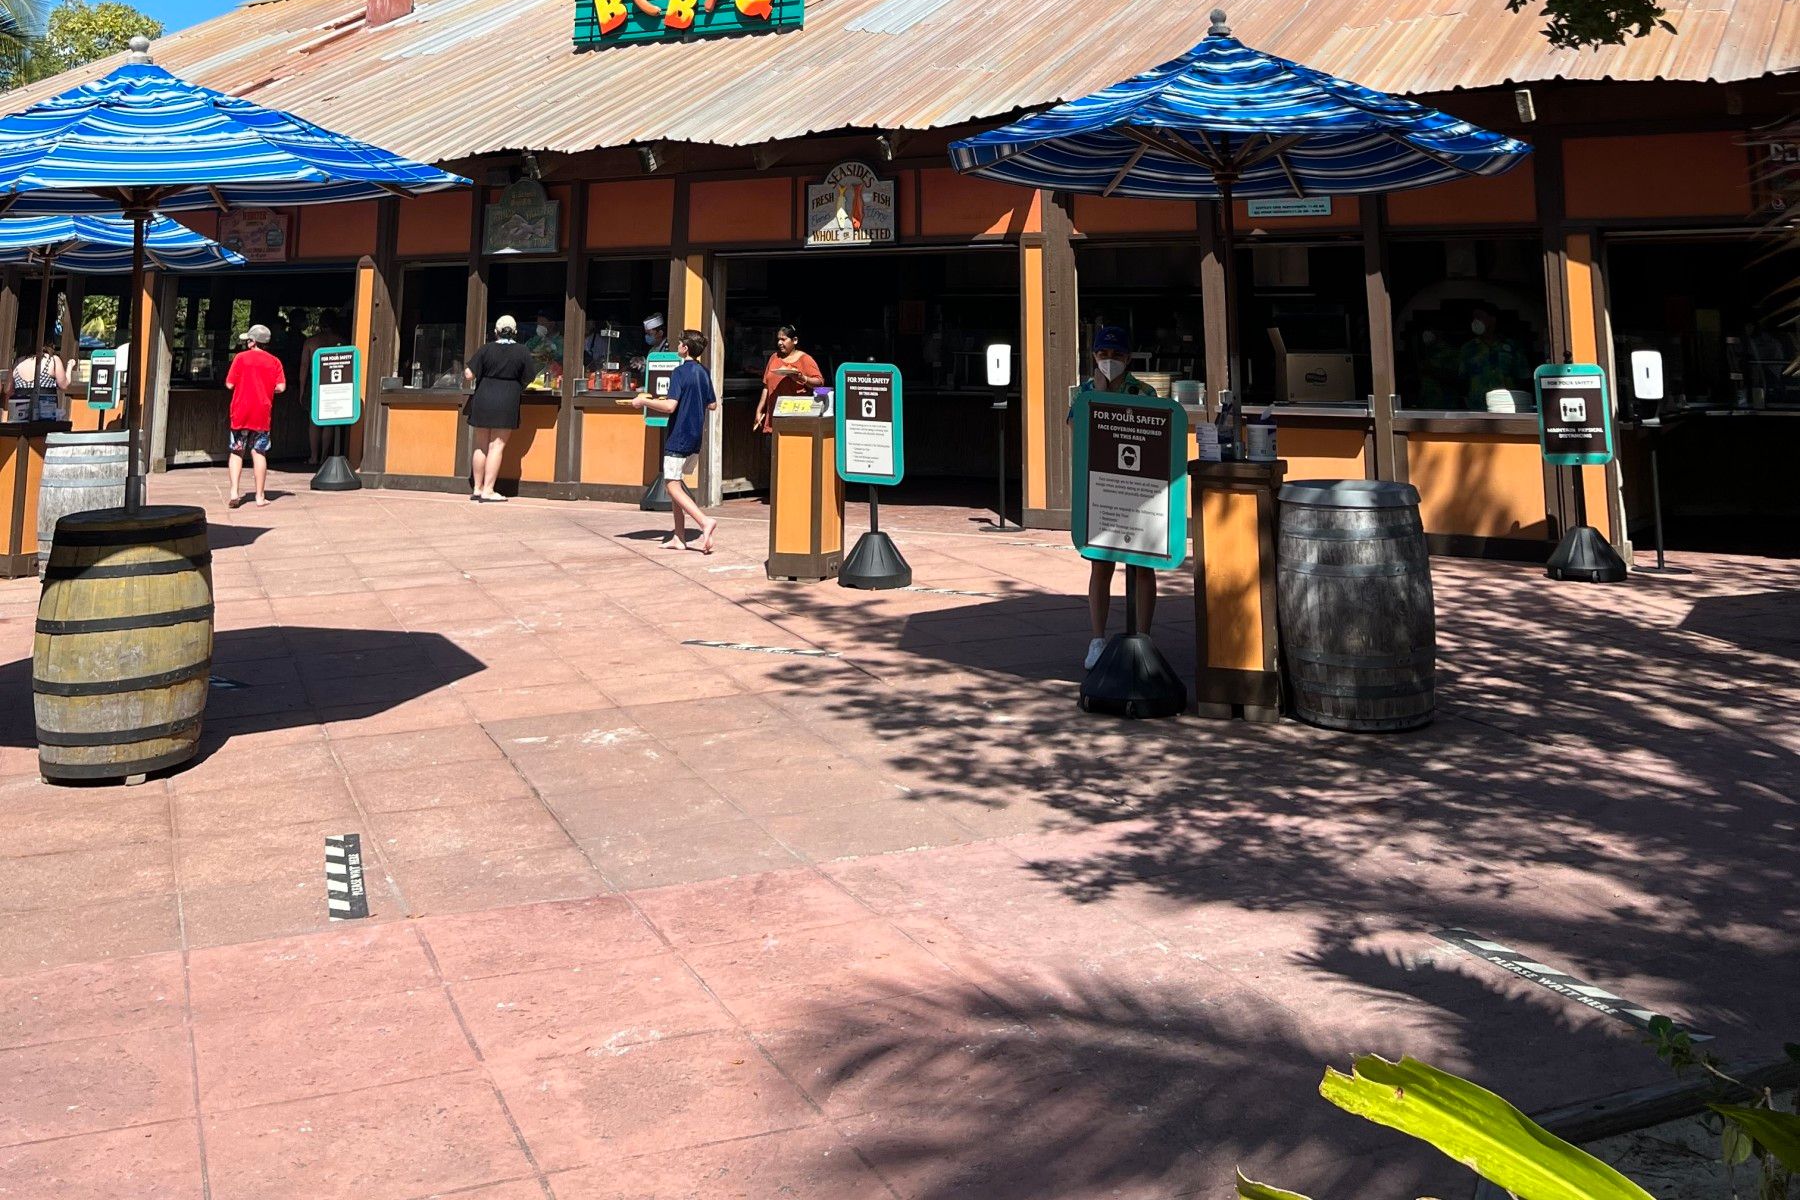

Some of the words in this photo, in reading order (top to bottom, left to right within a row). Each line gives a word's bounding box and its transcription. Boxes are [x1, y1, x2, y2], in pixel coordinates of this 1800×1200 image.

[812, 192, 835, 210] FRESH
[873, 191, 891, 207] FISH
[812, 229, 839, 242] WHOLE
[853, 228, 891, 241] FILLETED
[858, 376, 872, 384] YOUR
[1093, 410, 1110, 420] FOR
[1111, 412, 1135, 423] YOUR
[1136, 415, 1167, 426] SAFETY
[1097, 423, 1110, 431] FACE
[1110, 425, 1136, 434] COVERING
[1136, 428, 1162, 437] REQUIRED
[1120, 433, 1132, 441] THIS
[1487, 956, 1539, 979] PLEASE
[1538, 977, 1581, 996] WAIT
[1577, 996, 1619, 1015] HERE
